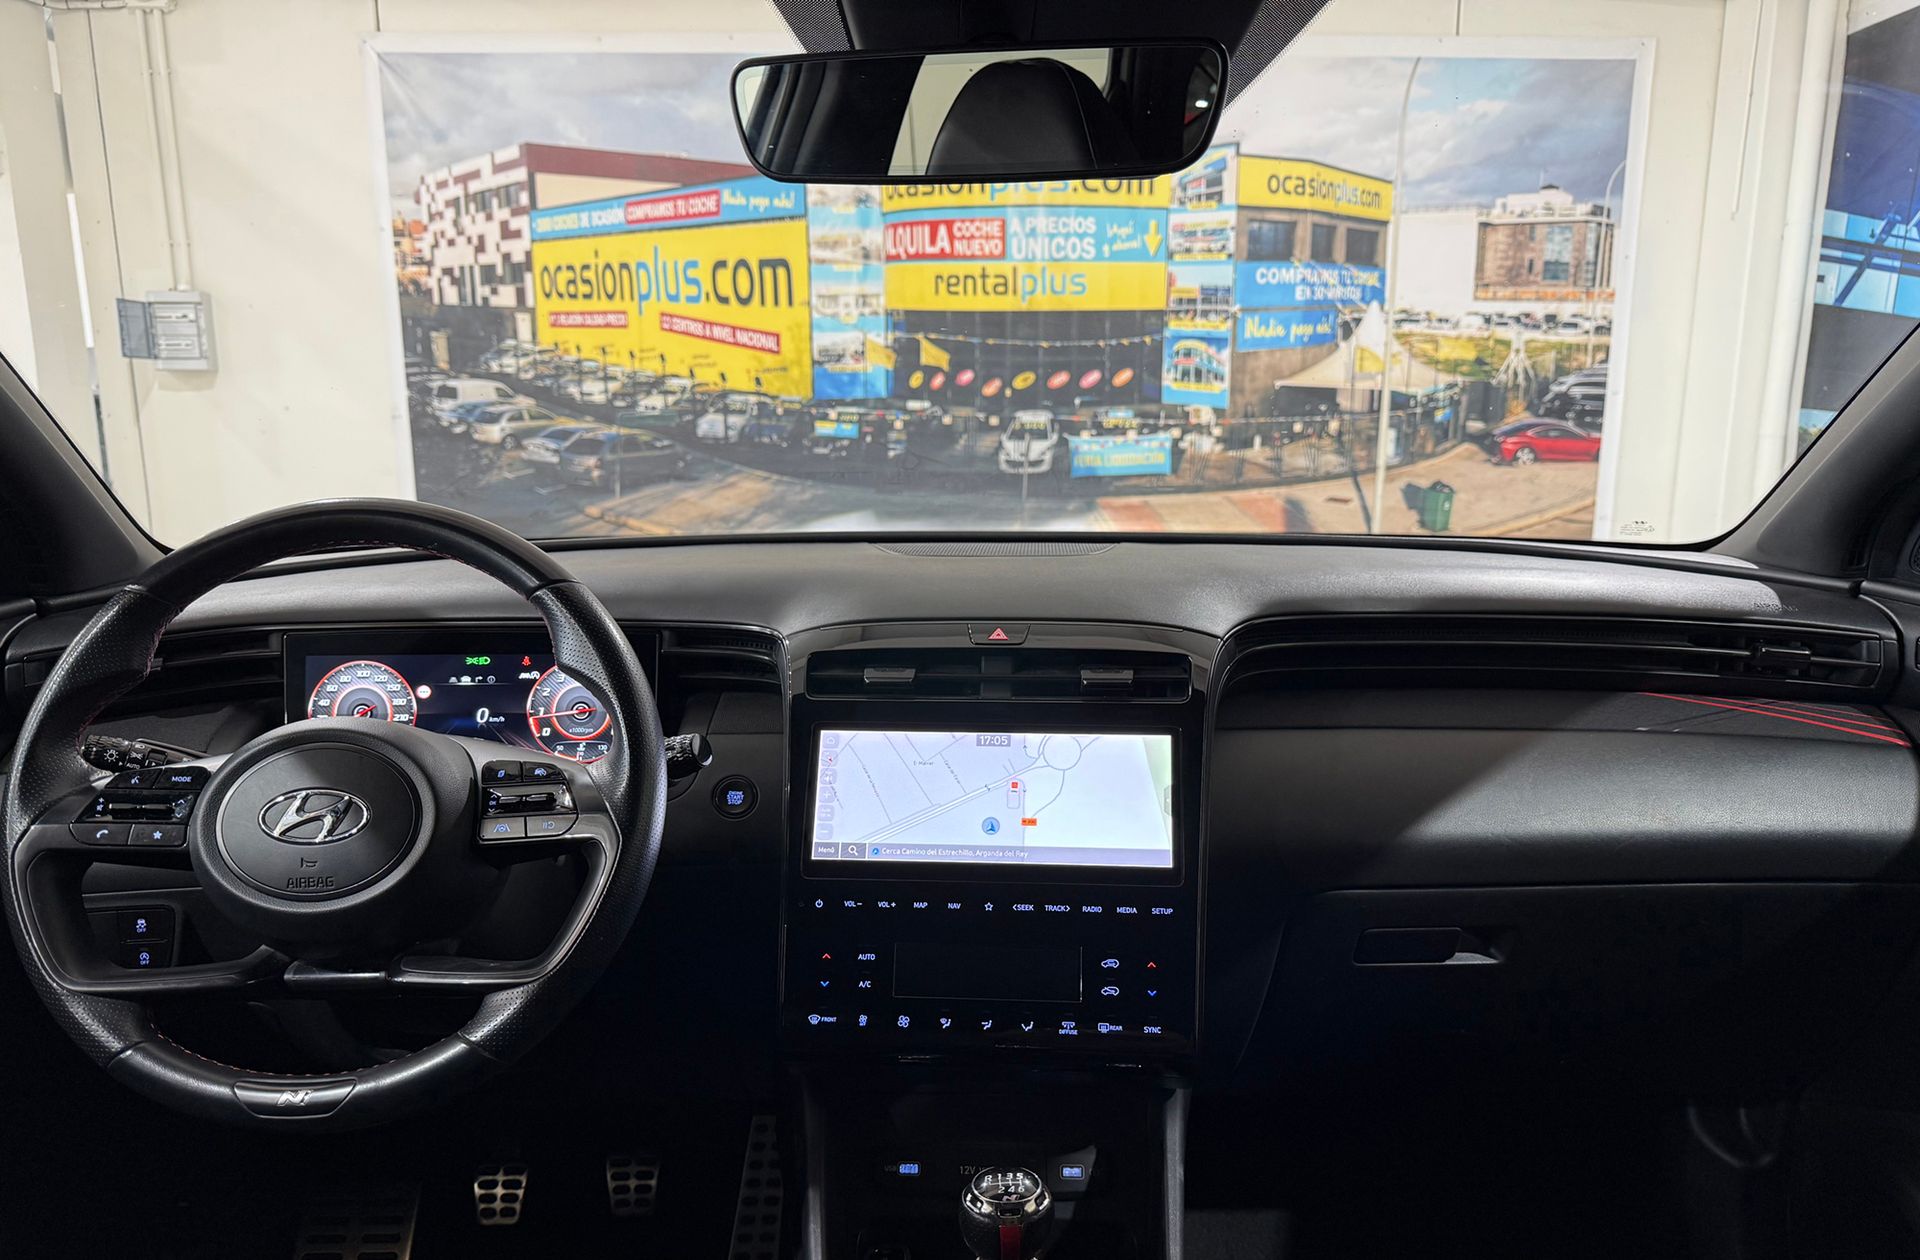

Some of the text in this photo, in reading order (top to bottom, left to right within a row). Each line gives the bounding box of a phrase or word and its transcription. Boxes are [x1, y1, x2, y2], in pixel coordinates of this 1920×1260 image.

[1267, 171, 1382, 209] ocasionplus.com
[1010, 216, 1097, 234] A PRECIOS
[953, 221, 1004, 238] COCHE
[953, 238, 1004, 257] NUEVO
[541, 245, 794, 316] ocasionplus.com
[935, 266, 1088, 303] rentalplus
[356, 670, 371, 678] 100
[340, 675, 352, 683] 80
[374, 675, 388, 683] 120
[555, 674, 565, 685] 3
[326, 684, 338, 692] 60
[386, 684, 401, 692] 150
[543, 688, 551, 697] 2
[318, 698, 331, 707] 40
[392, 698, 407, 706] 180
[392, 714, 409, 722] 210
[476, 707, 505, 724] 0 km/h
[542, 727, 551, 737] 0
[979, 735, 1009, 746] 17:05
[126, 762, 141, 770] AUTO
[171, 775, 193, 783] MODE
[881, 847, 901, 856] Cerca
[901, 848, 926, 857] Camino
[926, 848, 938, 857] del
[1004, 850, 1015, 858] del
[286, 875, 335, 889] AIRBAG
[913, 901, 928, 909] MAP
[948, 902, 961, 910] NAV
[1082, 905, 1102, 913] RADIO
[1117, 906, 1138, 914] MEDIA
[1151, 907, 1173, 915] SETUP
[858, 953, 876, 961] AUTO
[858, 980, 872, 988] A/C
[1143, 1026, 1162, 1034] SYNC
[959, 1166, 976, 1175] 12V
[984, 1174, 993, 1184] R
[1006, 1172, 1013, 1180] 3
[1016, 1172, 1024, 1180] 5
[997, 1185, 1025, 1194] 2 4 6
